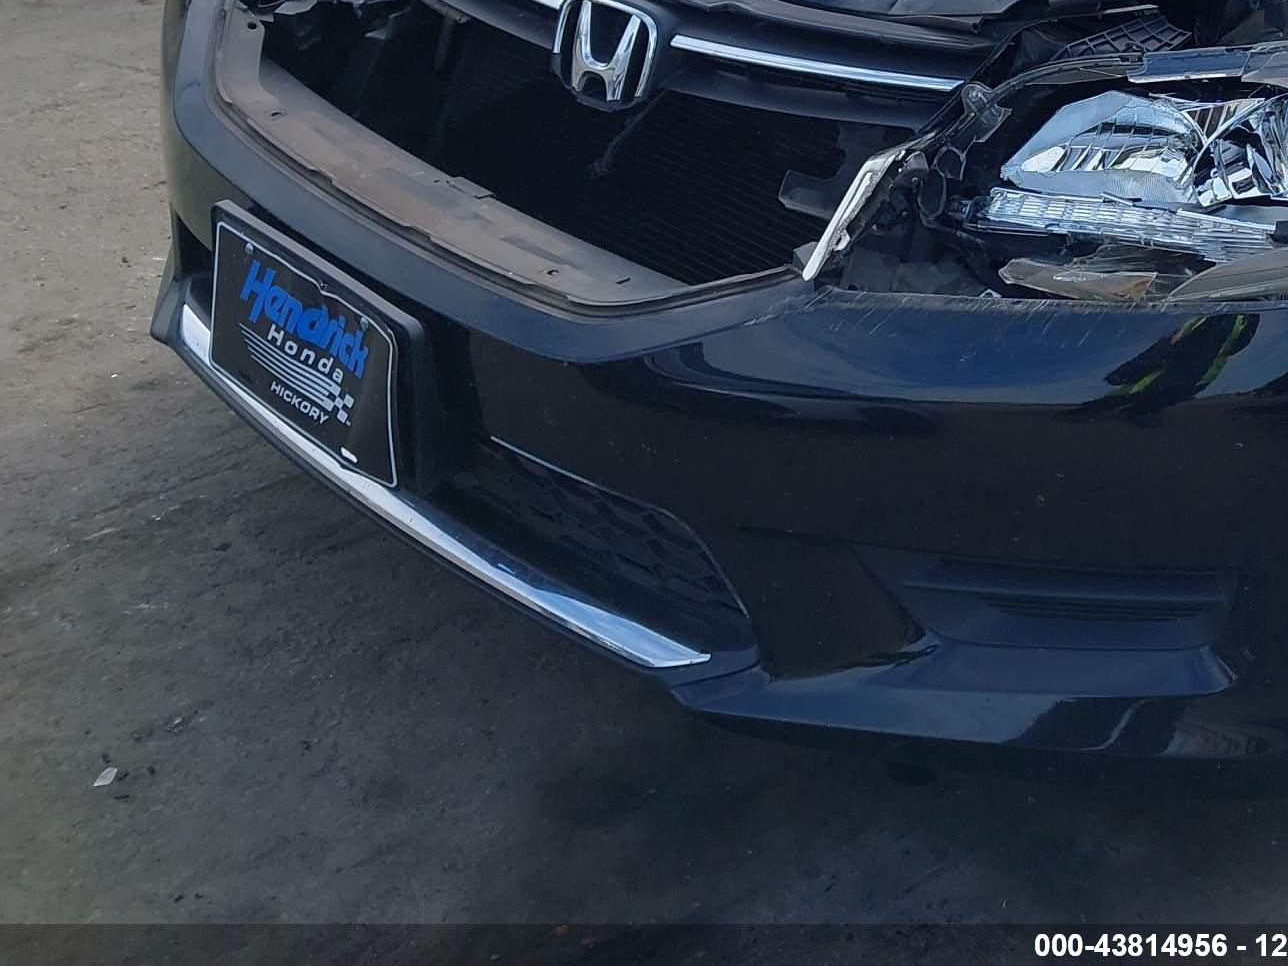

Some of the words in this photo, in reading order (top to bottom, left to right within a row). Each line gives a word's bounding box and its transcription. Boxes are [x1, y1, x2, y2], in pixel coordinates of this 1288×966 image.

[239, 259, 369, 378] Hendrick
[266, 324, 344, 384] Honda
[270, 381, 330, 425] HICKORY
